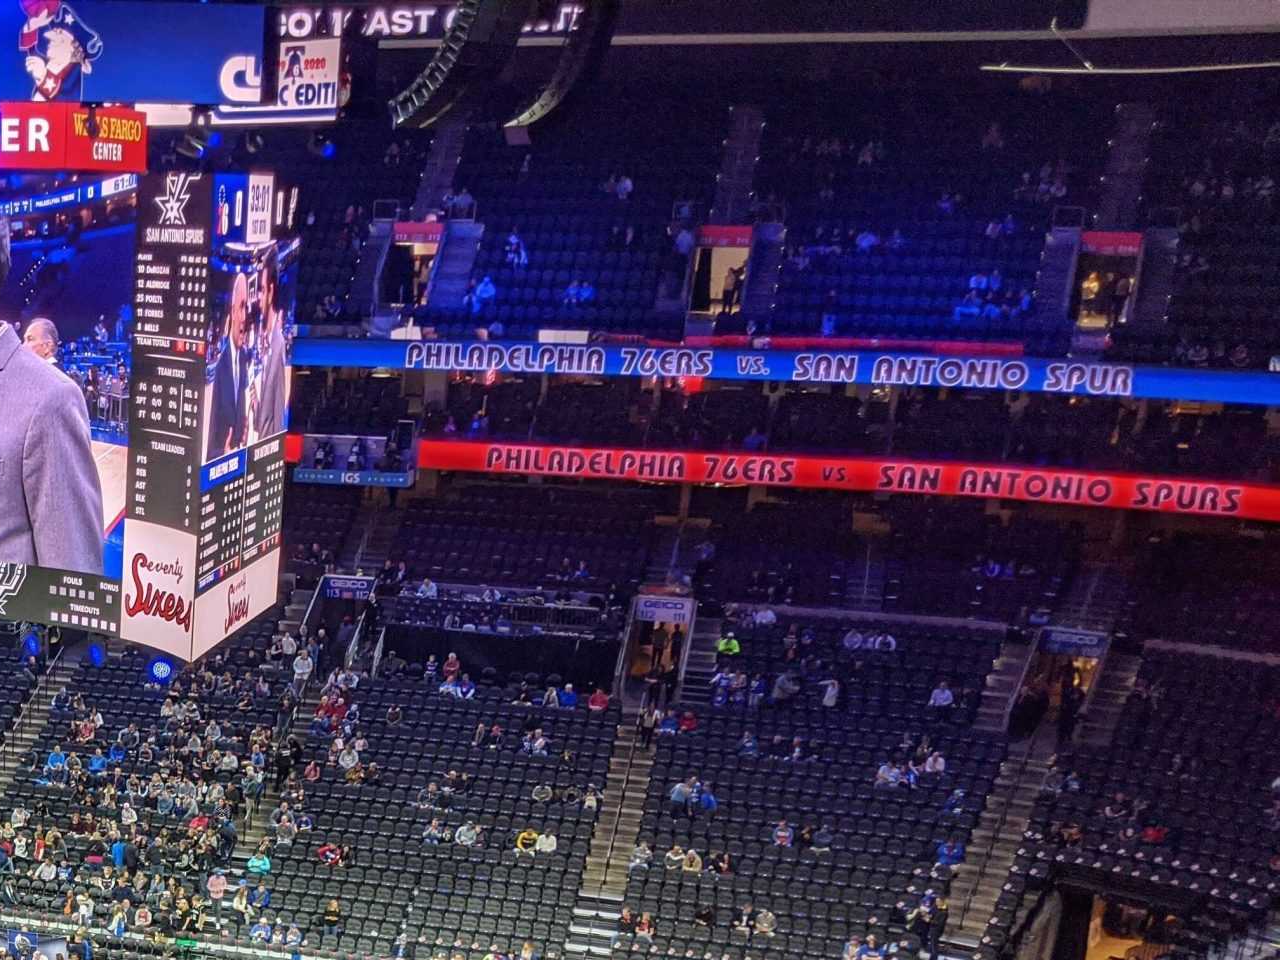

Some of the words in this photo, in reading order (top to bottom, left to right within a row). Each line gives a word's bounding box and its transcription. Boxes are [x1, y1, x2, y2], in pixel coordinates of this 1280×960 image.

[110, 117, 142, 142] FARGO
[92, 142, 122, 161] CENTER
[146, 228, 160, 243] SAN
[161, 228, 184, 243] ANTONIO
[185, 229, 204, 244] SPURS
[137, 337, 151, 346] TEAM
[151, 338, 171, 348] TOTALS
[158, 367, 172, 378] TEAM
[172, 369, 187, 379] STATS
[405, 342, 605, 375] PHILADELPHIA
[620, 349, 713, 377] 76ERS
[736, 354, 771, 377] VS.
[792, 353, 859, 383] SAN
[871, 356, 1029, 390] ANTONIO
[1043, 362, 1133, 397] SPUR
[151, 441, 166, 452] TEAM
[166, 443, 185, 456] LEADERS
[136, 455, 147, 465] PTS
[340, 472, 361, 484] IGS
[486, 446, 686, 479] PHILADELPHIA
[703, 455, 797, 484] 76ERS
[821, 466, 851, 484] VS.
[878, 464, 942, 491] SAN
[958, 469, 1113, 503] ANTONIO
[1131, 480, 1243, 514] SPURS
[136, 481, 146, 490] AST
[63, 576, 84, 586] FOULS
[99, 582, 120, 592] BONUS
[330, 579, 368, 589] GEICO
[69, 603, 100, 616] TIMEOUTS
[125, 583, 192, 633] Sixers
[643, 600, 685, 610] GEICO
